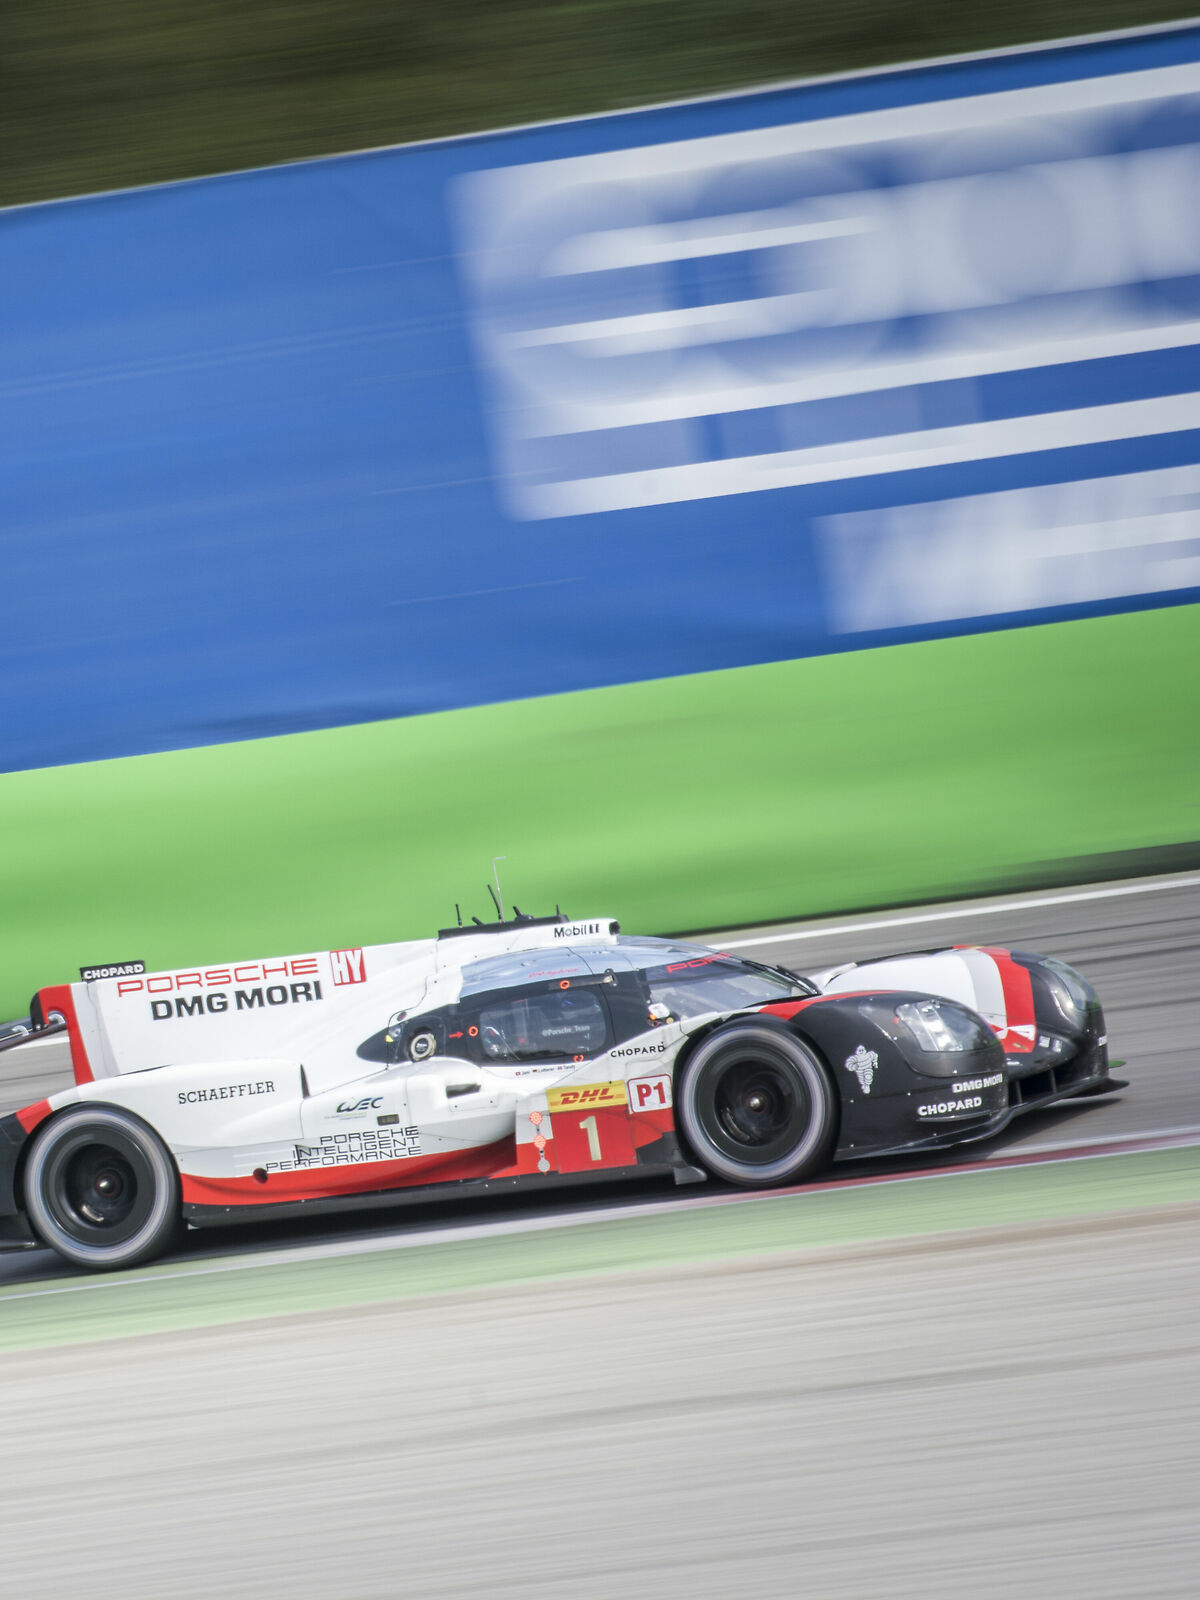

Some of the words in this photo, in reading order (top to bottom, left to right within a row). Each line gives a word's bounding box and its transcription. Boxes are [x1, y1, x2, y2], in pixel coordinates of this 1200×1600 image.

[554, 924, 587, 938] Mobil
[83, 963, 144, 980] CHOPARD
[330, 948, 365, 985] HY
[117, 958, 319, 998] PORSCHE
[151, 992, 229, 1021] DMG
[234, 980, 323, 1011] MORI
[611, 1045, 665, 1058] CHOPARD
[178, 1080, 275, 1105] SCHAEFFLER
[636, 1082, 667, 1107] P1
[952, 1079, 982, 1094] DMG
[983, 1073, 1003, 1087] MORI
[336, 1097, 384, 1113] WEC
[560, 1088, 615, 1105] DHL
[917, 1096, 982, 1116] CHOPARD
[320, 1125, 419, 1146] PORSCHE
[579, 1115, 602, 1161] 1
[293, 1136, 420, 1159] INTELLIGENT
[265, 1146, 423, 1172] PERFORMANCE
